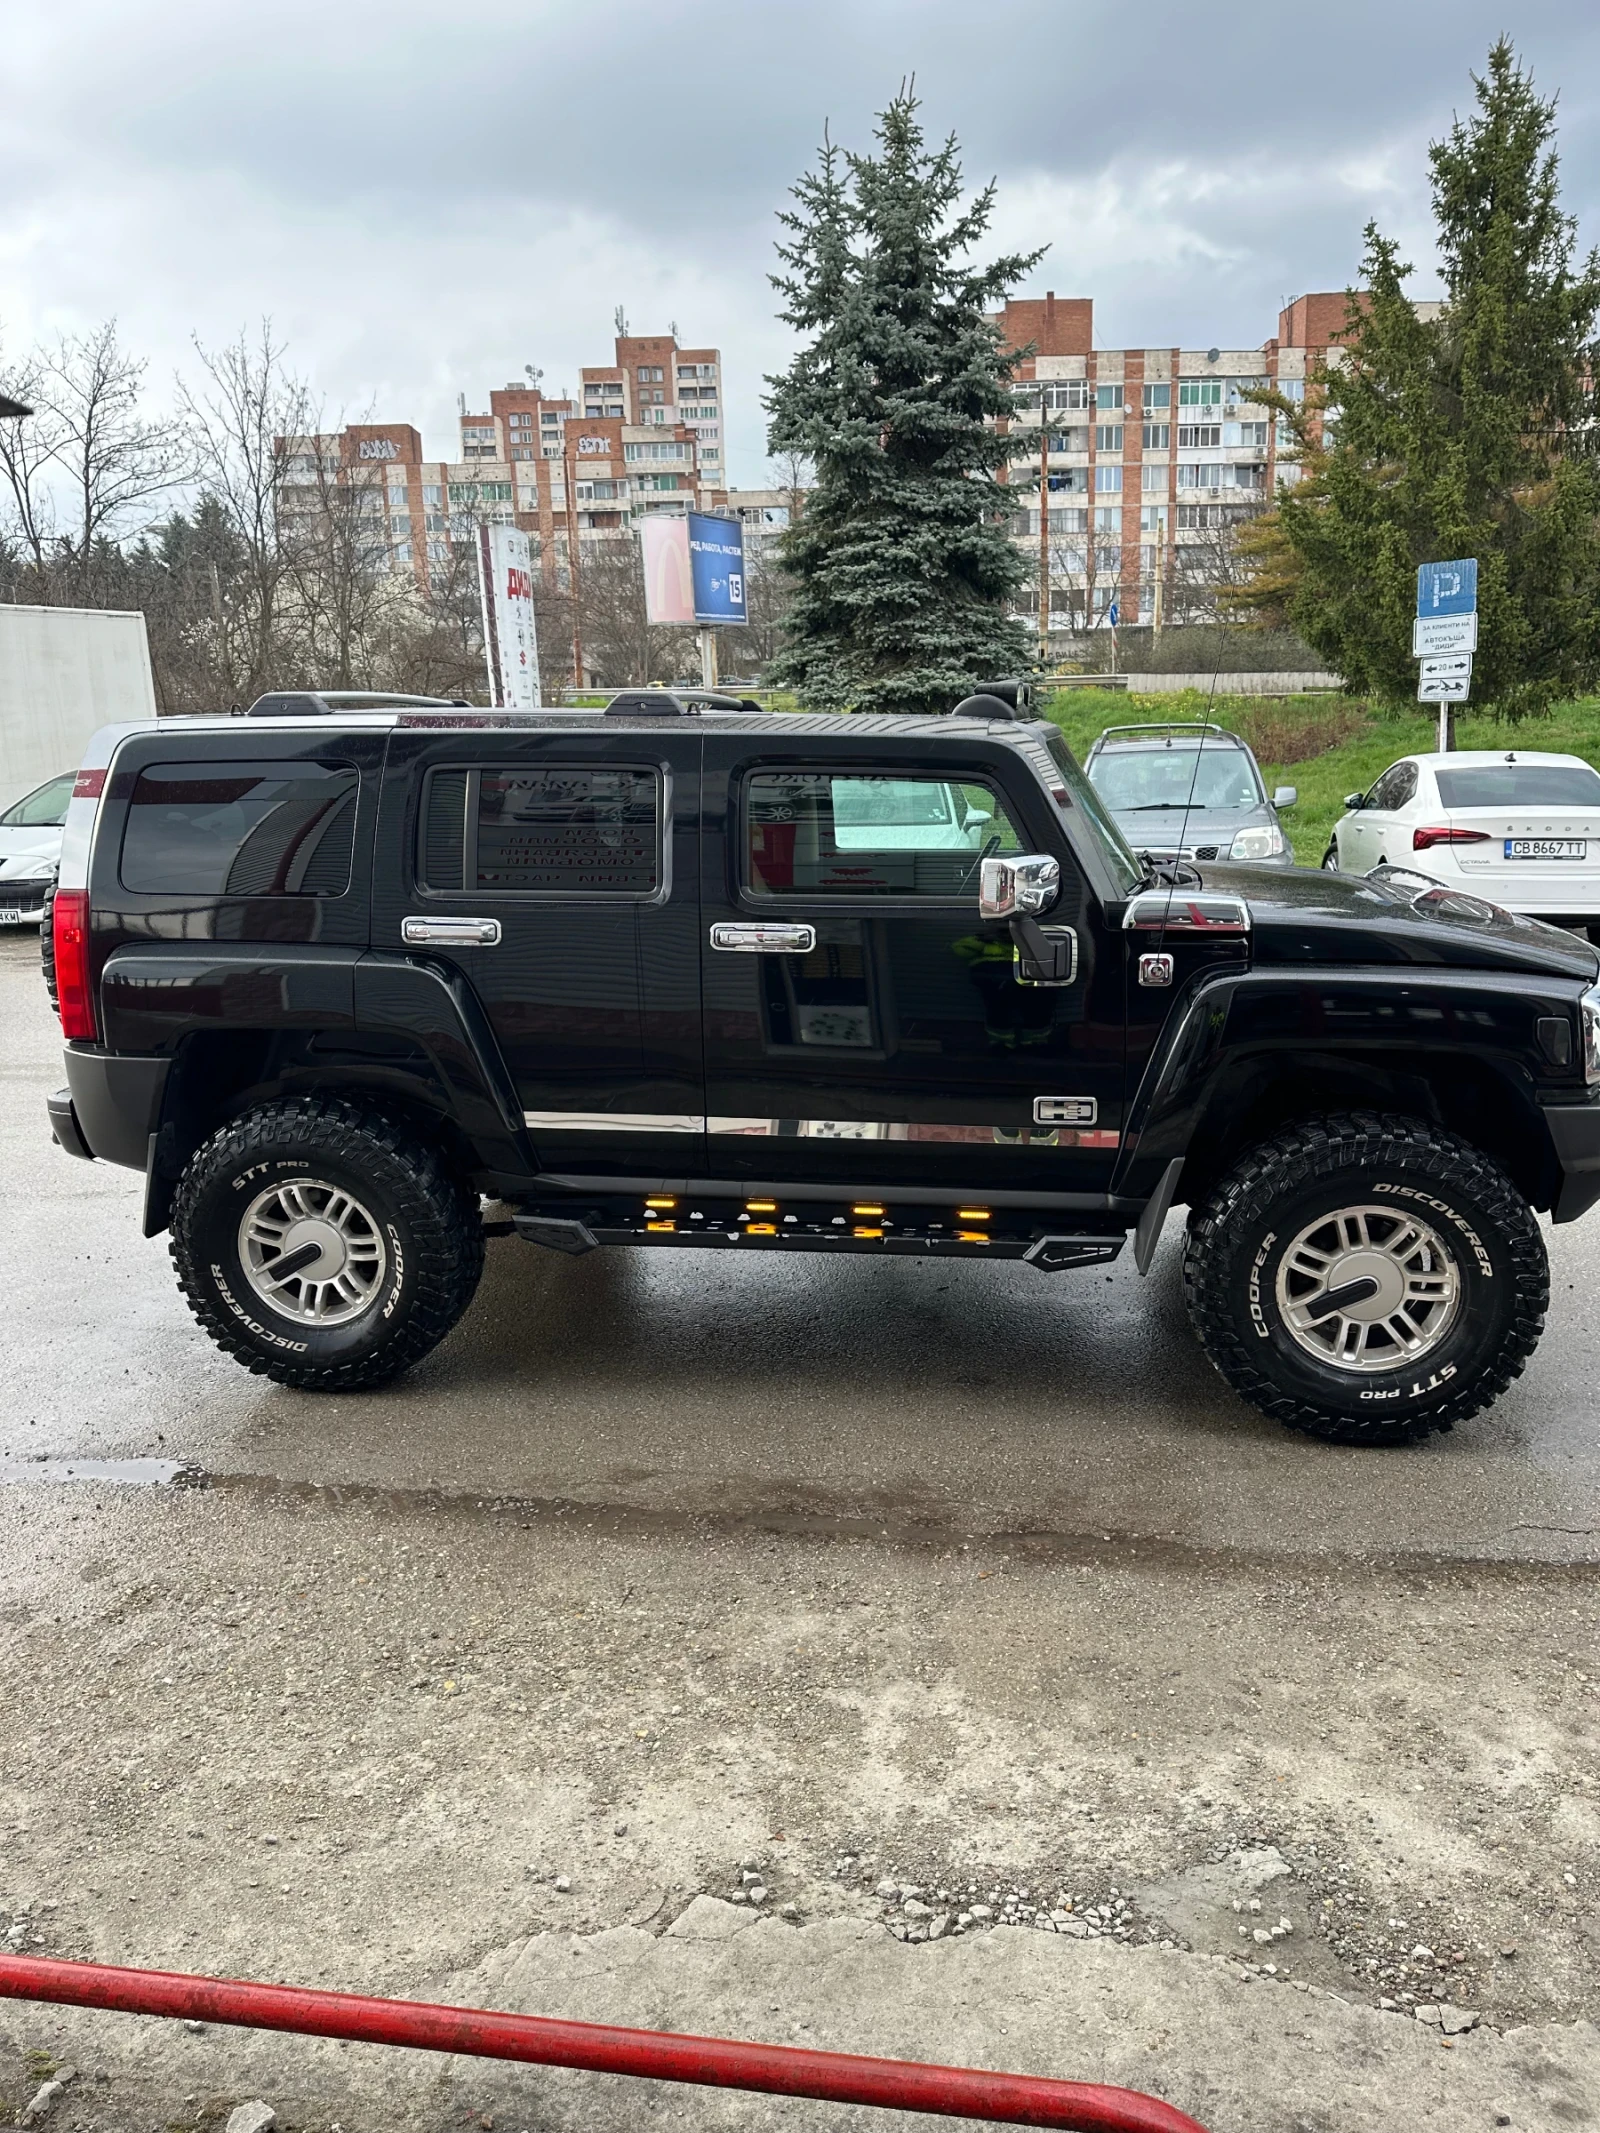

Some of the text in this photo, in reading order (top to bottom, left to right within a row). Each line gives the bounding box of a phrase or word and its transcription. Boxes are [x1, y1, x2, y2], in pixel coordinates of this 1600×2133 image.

[730, 580, 741, 598] 15
[1433, 572, 1461, 608] P
[1424, 634, 1466, 644] АВТОКЪЩА
[1432, 622, 1460, 631] КЛИЕНТИ
[1438, 663, 1447, 671] 20
[1513, 842, 1583, 855] CB 8667 TT
[232, 1160, 310, 1191] STT PRO
[1372, 1182, 1493, 1277] DISCOVERER
[382, 1223, 404, 1319] COOPER
[1249, 1231, 1278, 1338] COOPER
[210, 1263, 309, 1353] DISCOVERER
[1359, 1360, 1458, 1400] STT PRO
